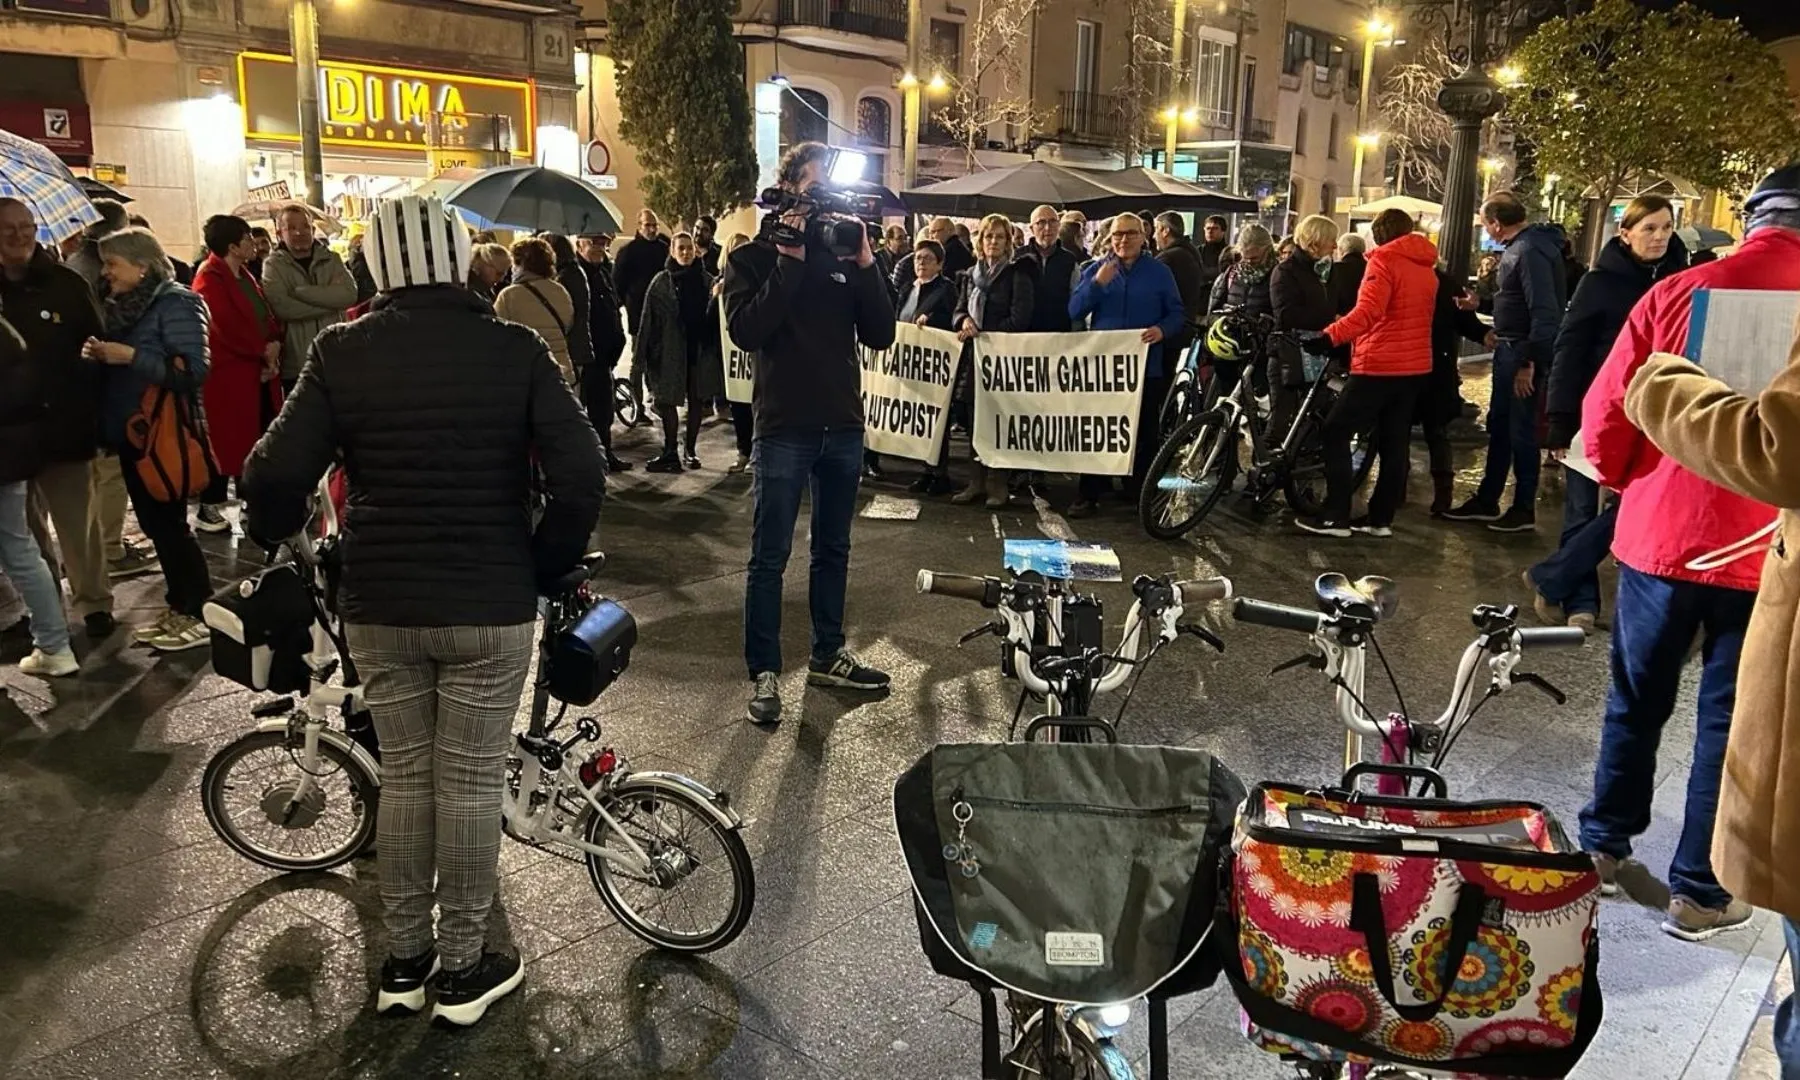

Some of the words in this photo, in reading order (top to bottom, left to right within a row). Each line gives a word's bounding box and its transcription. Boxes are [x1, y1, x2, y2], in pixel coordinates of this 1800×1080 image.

[544, 34, 564, 58] 21
[320, 67, 468, 129] DIMA
[981, 355, 1050, 392] SALVEM
[1057, 354, 1138, 393] GALILEU
[995, 414, 1000, 449] I
[1007, 414, 1130, 454] ARQUIMEDES
